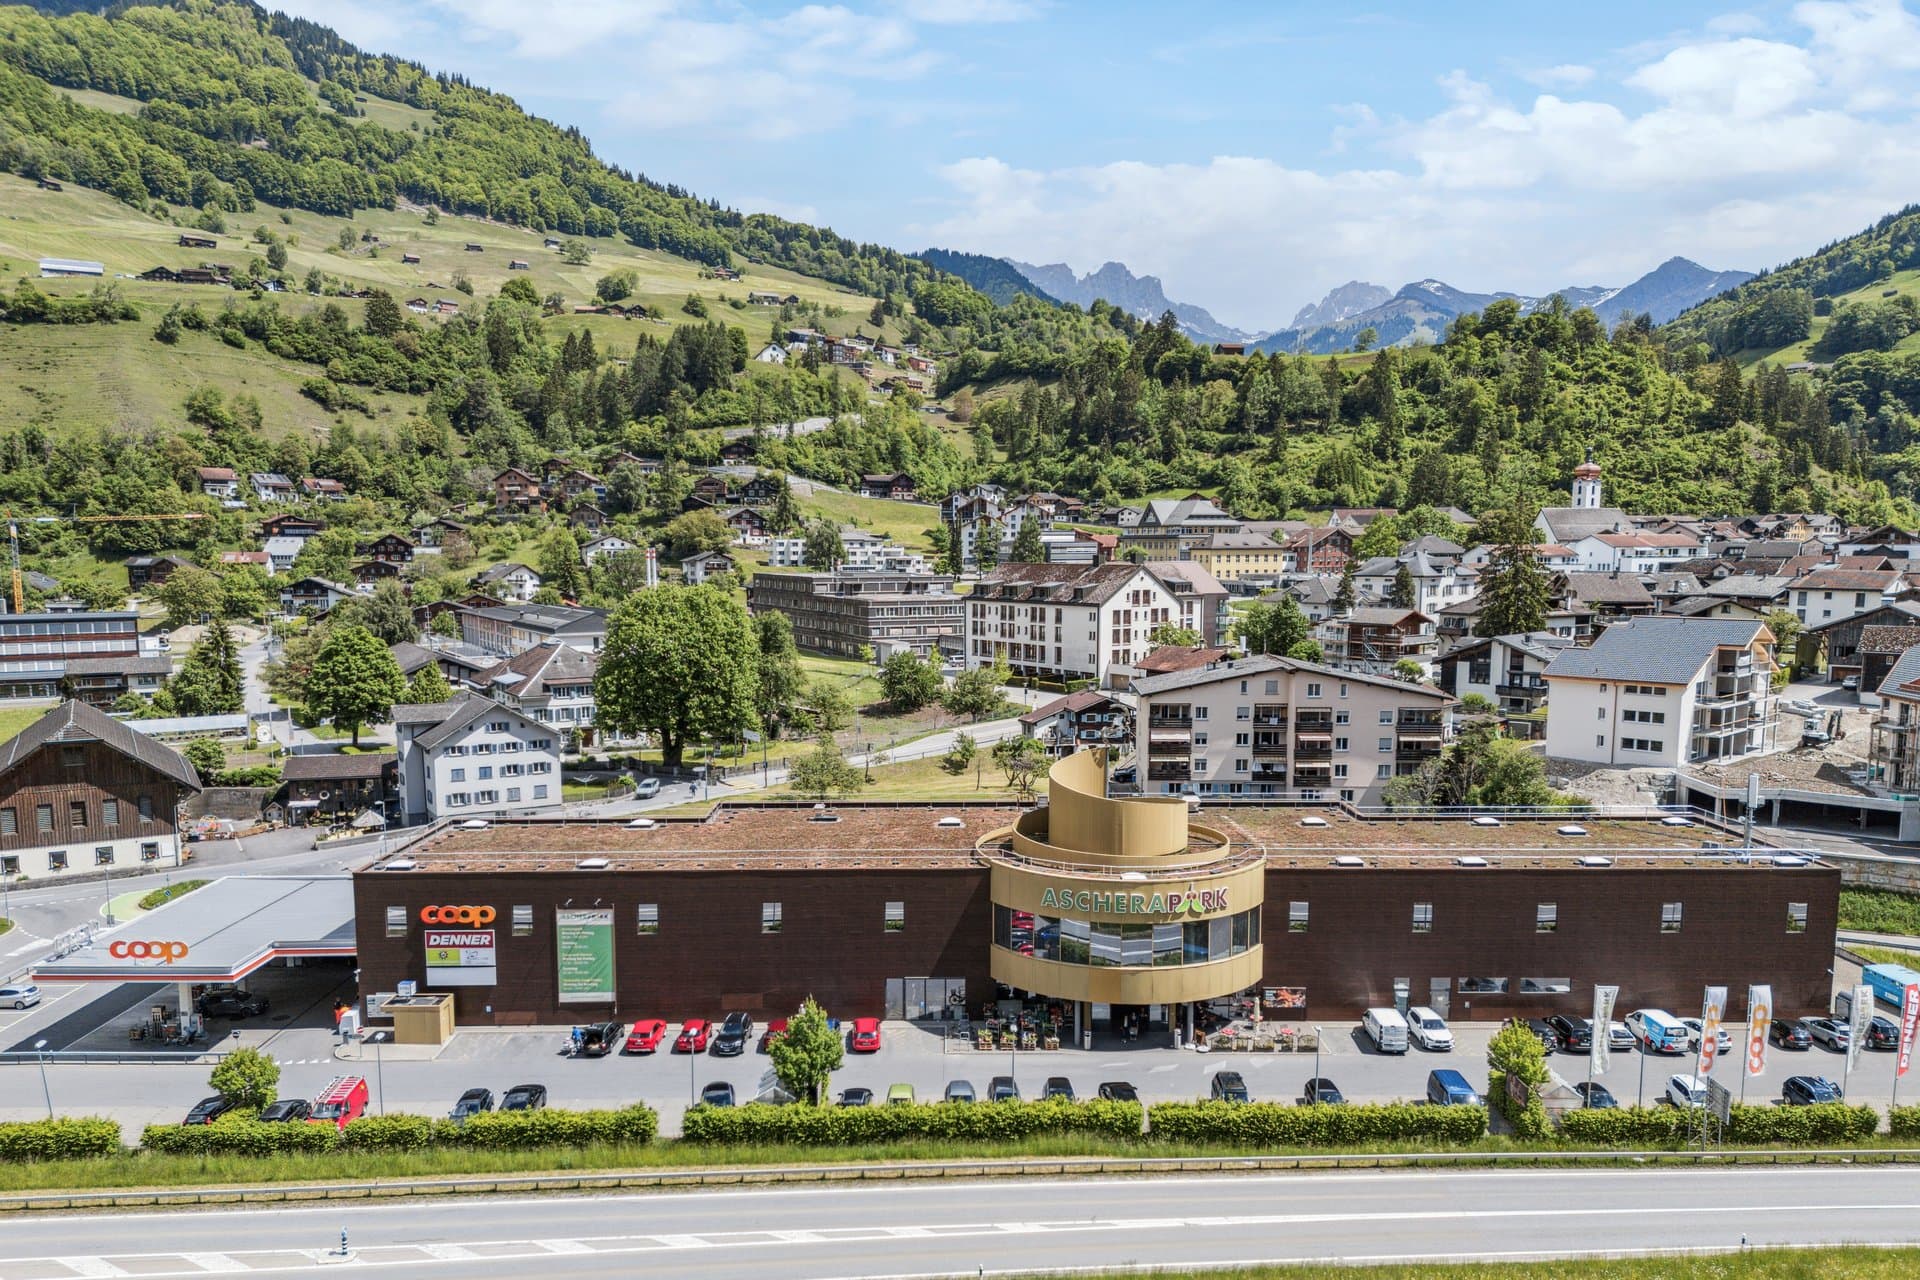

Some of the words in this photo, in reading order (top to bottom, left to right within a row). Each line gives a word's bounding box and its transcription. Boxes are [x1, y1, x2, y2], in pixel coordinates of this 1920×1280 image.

[420, 905, 497, 929] coop
[429, 934, 492, 946] DENNER
[109, 941, 189, 965] coop
[1700, 1004, 1721, 1073] coop
[1748, 1004, 1772, 1073] coop
[1900, 989, 1919, 1069] DENNER
